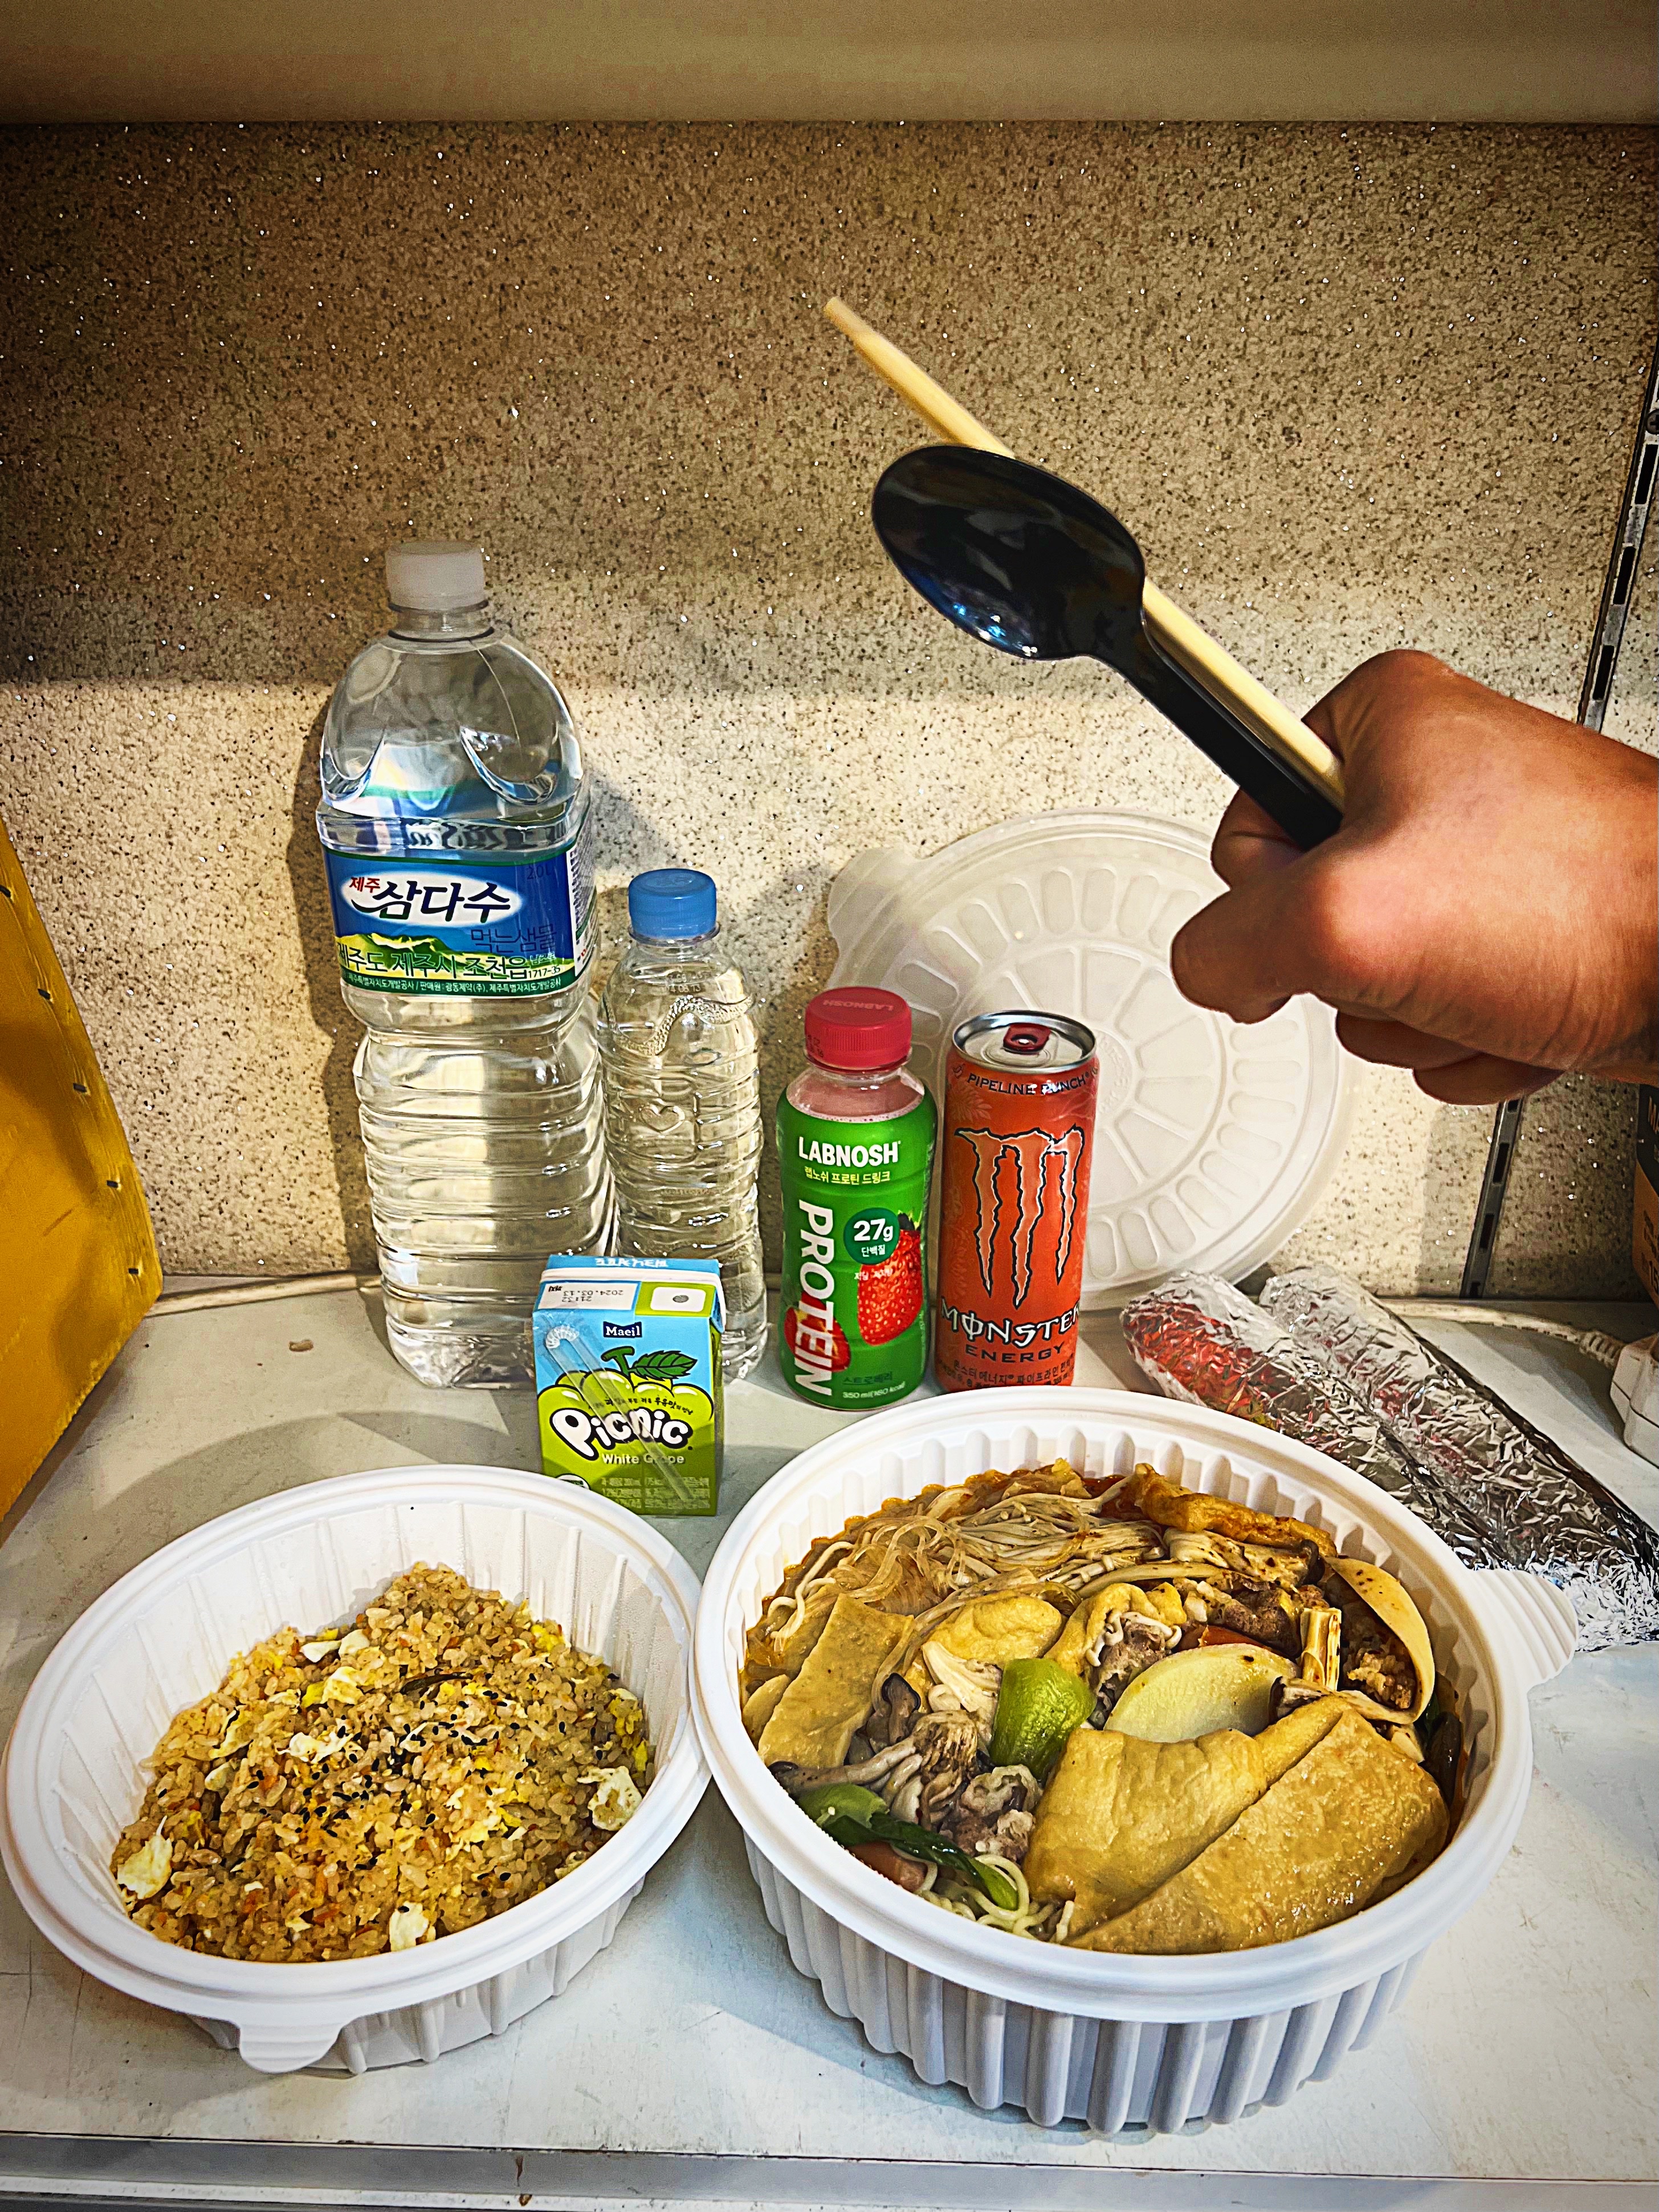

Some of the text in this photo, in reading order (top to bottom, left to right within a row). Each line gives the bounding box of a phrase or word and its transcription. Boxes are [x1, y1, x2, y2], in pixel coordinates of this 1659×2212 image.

[349, 877, 380, 893] 제주
[350, 881, 511, 923] 삼다수
[471, 923, 557, 954] 먹는샘물
[337, 942, 530, 980] 제주도 제주시 조천읍
[967, 1073, 1086, 1095] PIPELINE PUNCH
[799, 1136, 899, 1167] LABNOSH
[805, 1166, 890, 1185] 랩노쉬 프로틴 드링크
[853, 1219, 893, 1242] 27g
[861, 1244, 886, 1257] 단백질
[794, 1199, 835, 1396] PROTEIN
[605, 1326, 641, 1337] Maeil
[940, 1297, 1079, 1349] MONSTER
[965, 1341, 1065, 1363] ENERGY
[551, 1407, 691, 1458] Picnic
[601, 1453, 684, 1465] White Gpe
